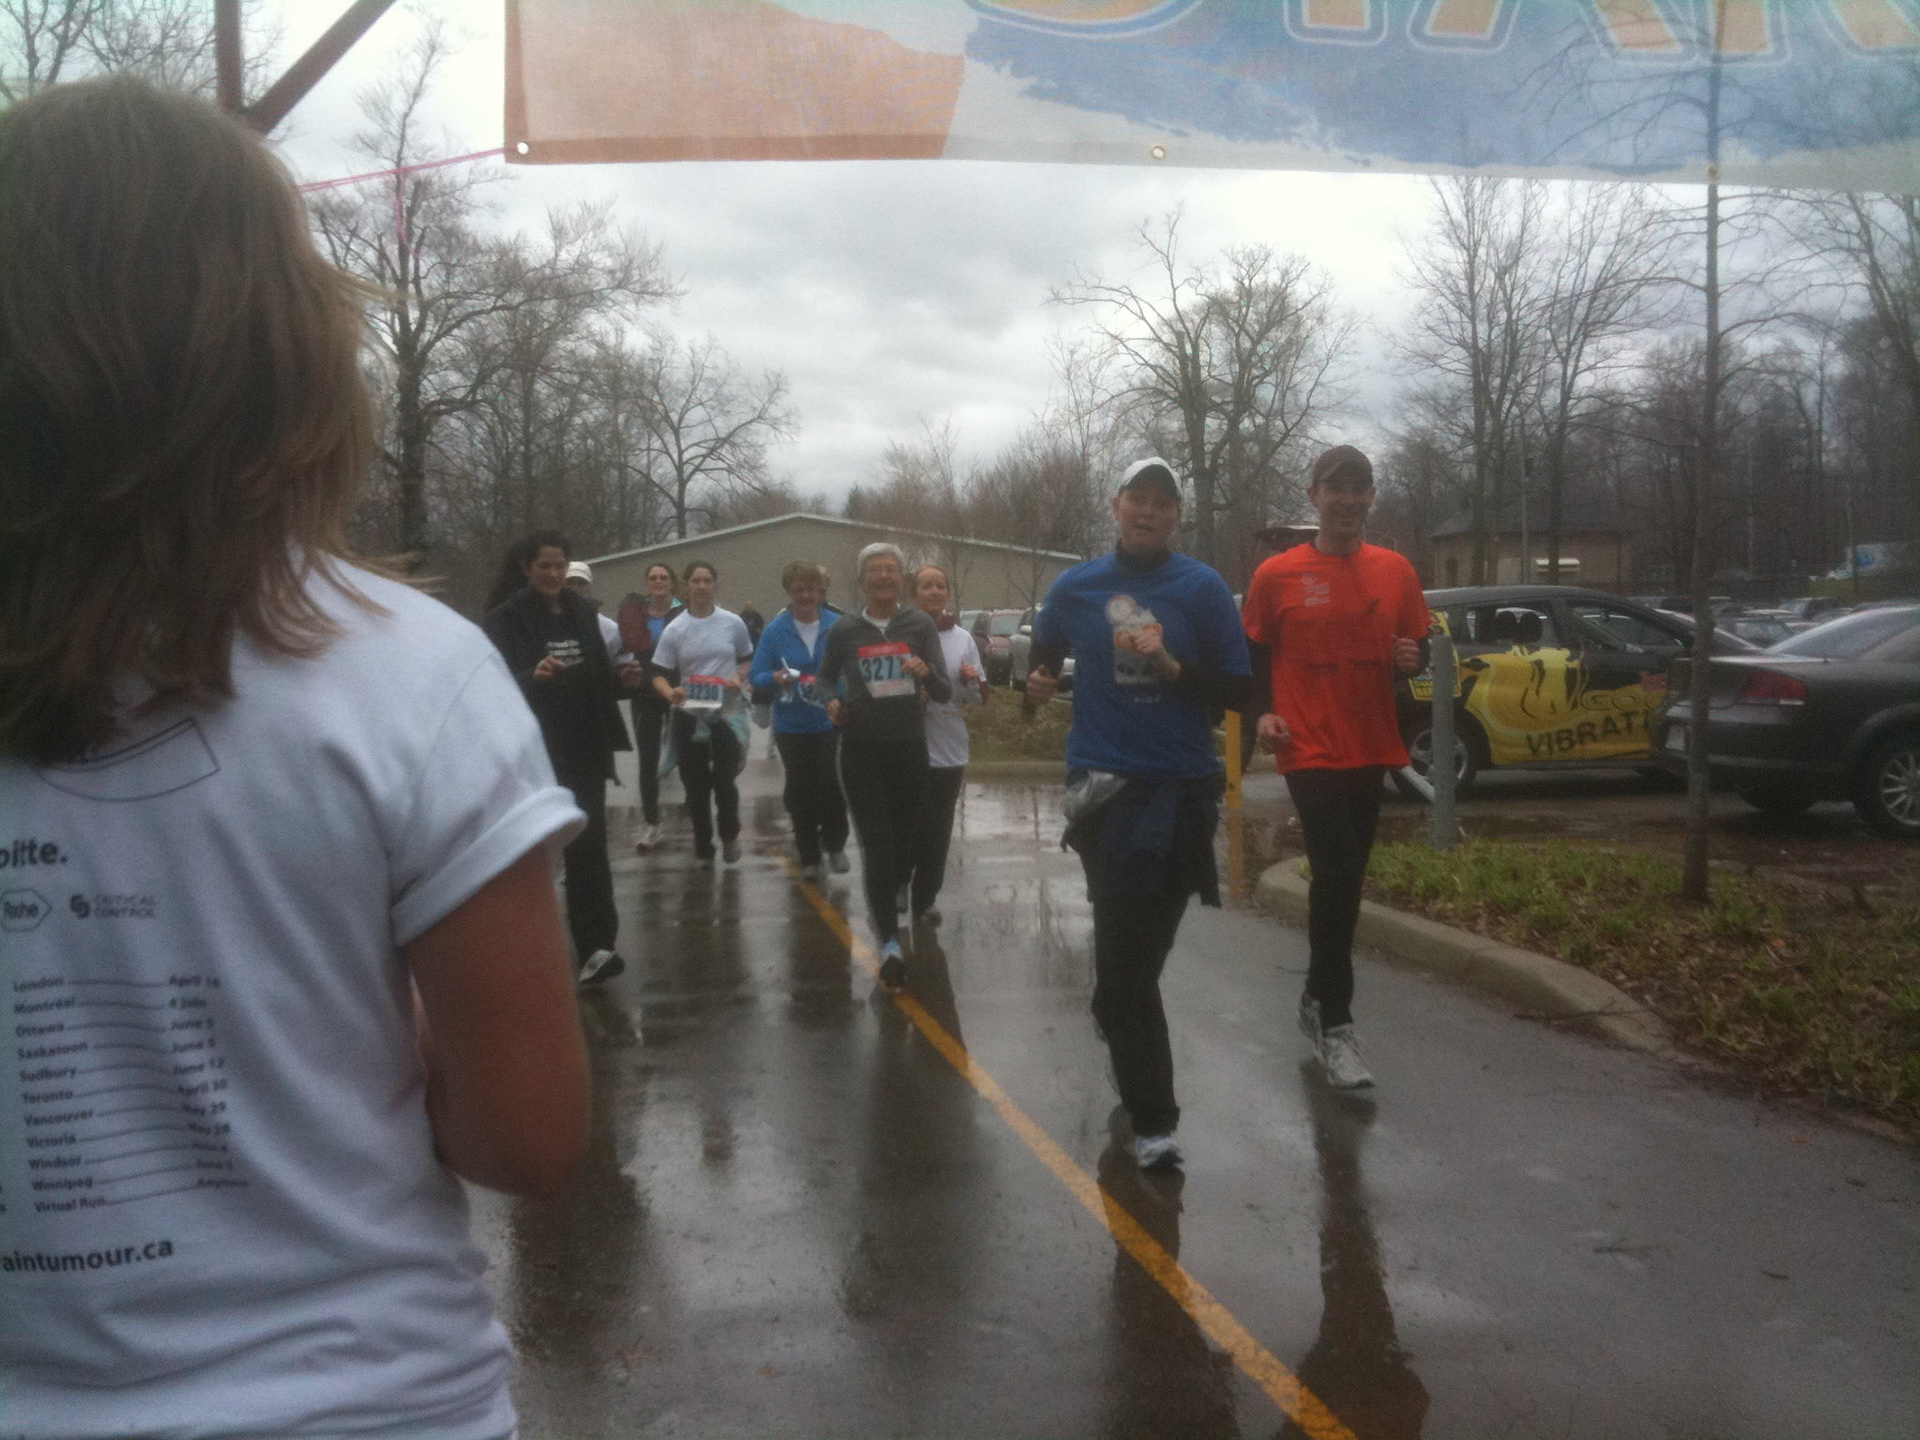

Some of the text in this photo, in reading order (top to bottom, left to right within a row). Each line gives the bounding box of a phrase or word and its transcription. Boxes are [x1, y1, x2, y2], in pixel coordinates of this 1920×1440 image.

[13, 977, 64, 993] London
[15, 1022, 65, 1038] Ottawa
[17, 1042, 88, 1060] Saskatoon
[19, 1066, 77, 1083] Sudbury
[22, 1089, 74, 1105] Toronto
[24, 1108, 94, 1127] Vancouver
[26, 1133, 77, 1149] Victoria
[29, 1155, 82, 1171] Windsor
[32, 1176, 94, 1192] Winnipeg
[34, 1198, 76, 1213] Virtual
[79, 1195, 106, 1208] Run
[2, 1239, 174, 1273] aintumour.ca
